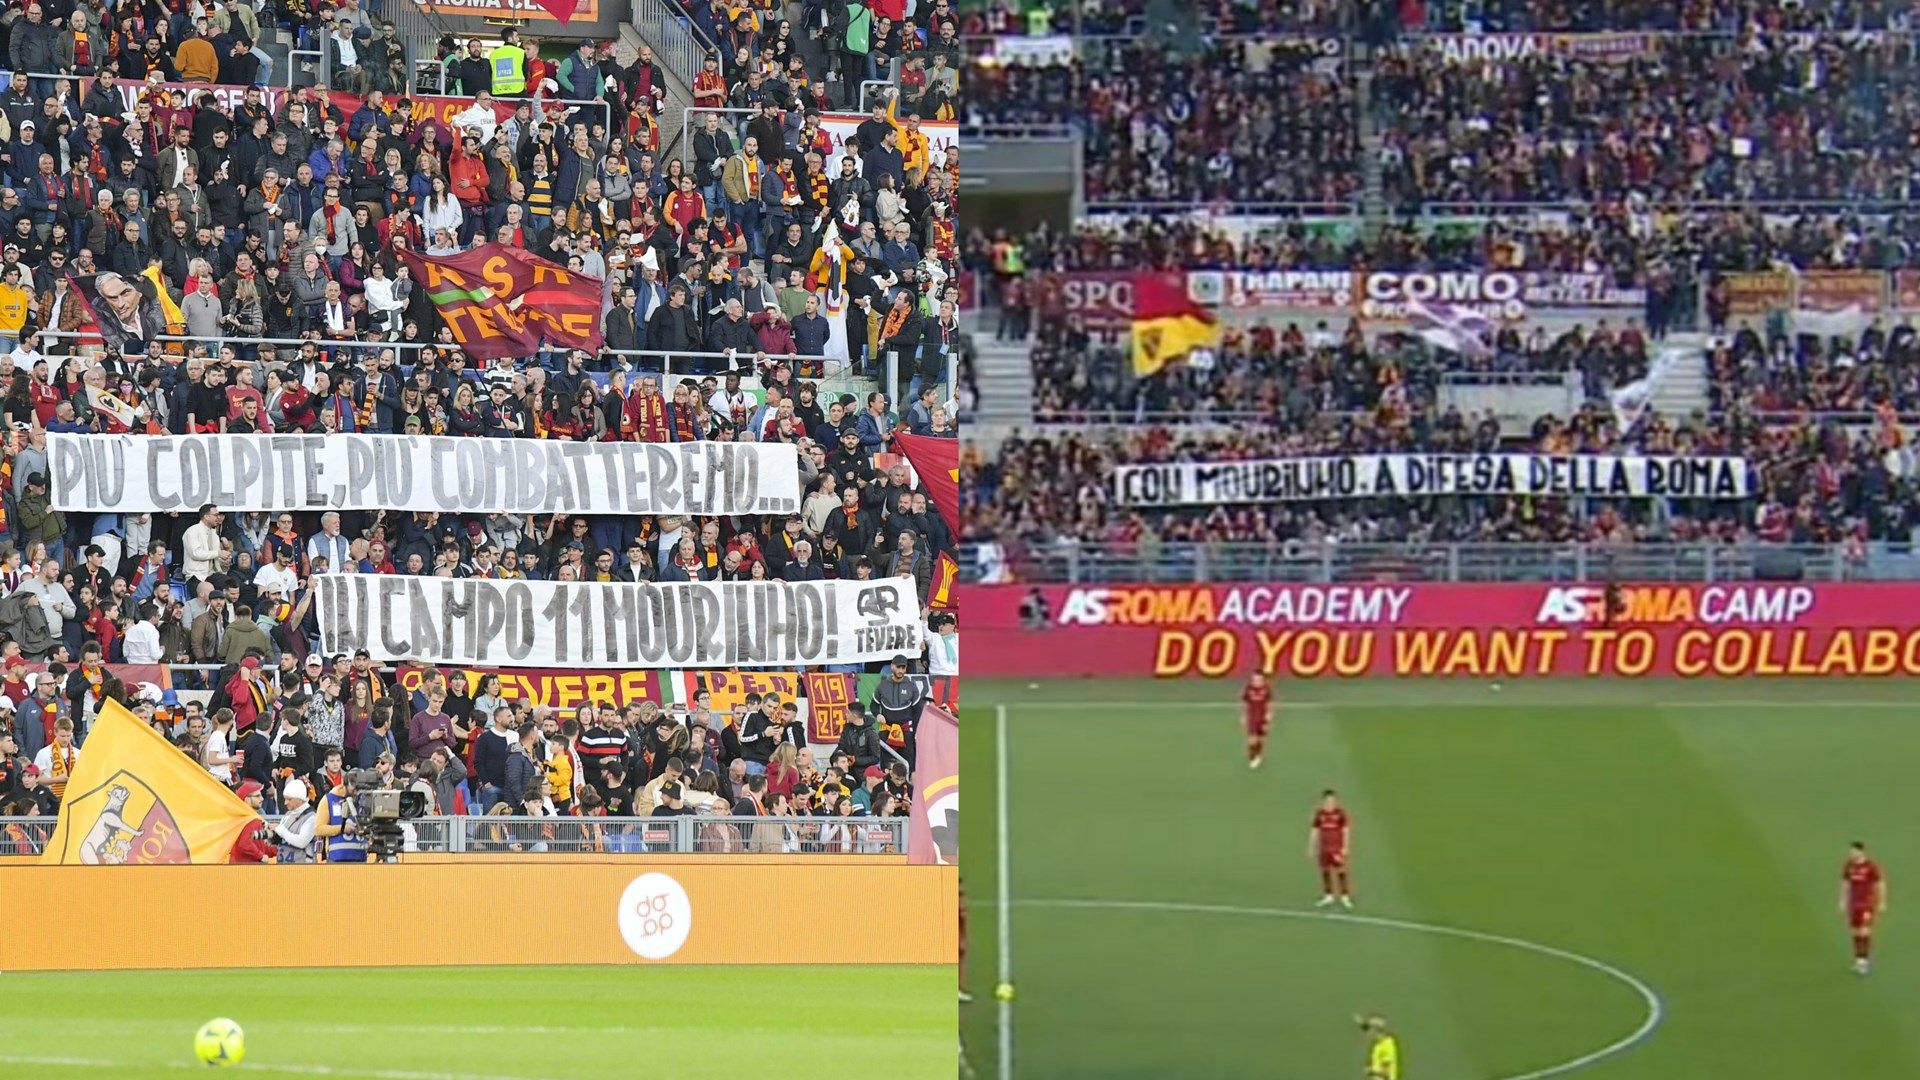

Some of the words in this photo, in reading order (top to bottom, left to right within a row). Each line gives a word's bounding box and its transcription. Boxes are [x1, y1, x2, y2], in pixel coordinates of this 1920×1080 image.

[1433, 36, 1537, 63] ADOVA
[1366, 273, 1519, 300] COMO
[1374, 458, 1396, 492] A
[1529, 457, 1628, 492] DELLA
[1645, 457, 1736, 494] ROMA
[380, 577, 534, 661] CAMPO
[1217, 588, 1412, 623] ACADEMY
[1700, 588, 1813, 623] CAMP
[854, 624, 916, 653] TEVERE
[1154, 629, 1239, 677] DO
[1255, 629, 1375, 677] YOU
[1395, 629, 1568, 677] WANT
[1582, 629, 1657, 677] TO
[463, 671, 648, 717] TEVERE
[814, 678, 846, 704] 19
